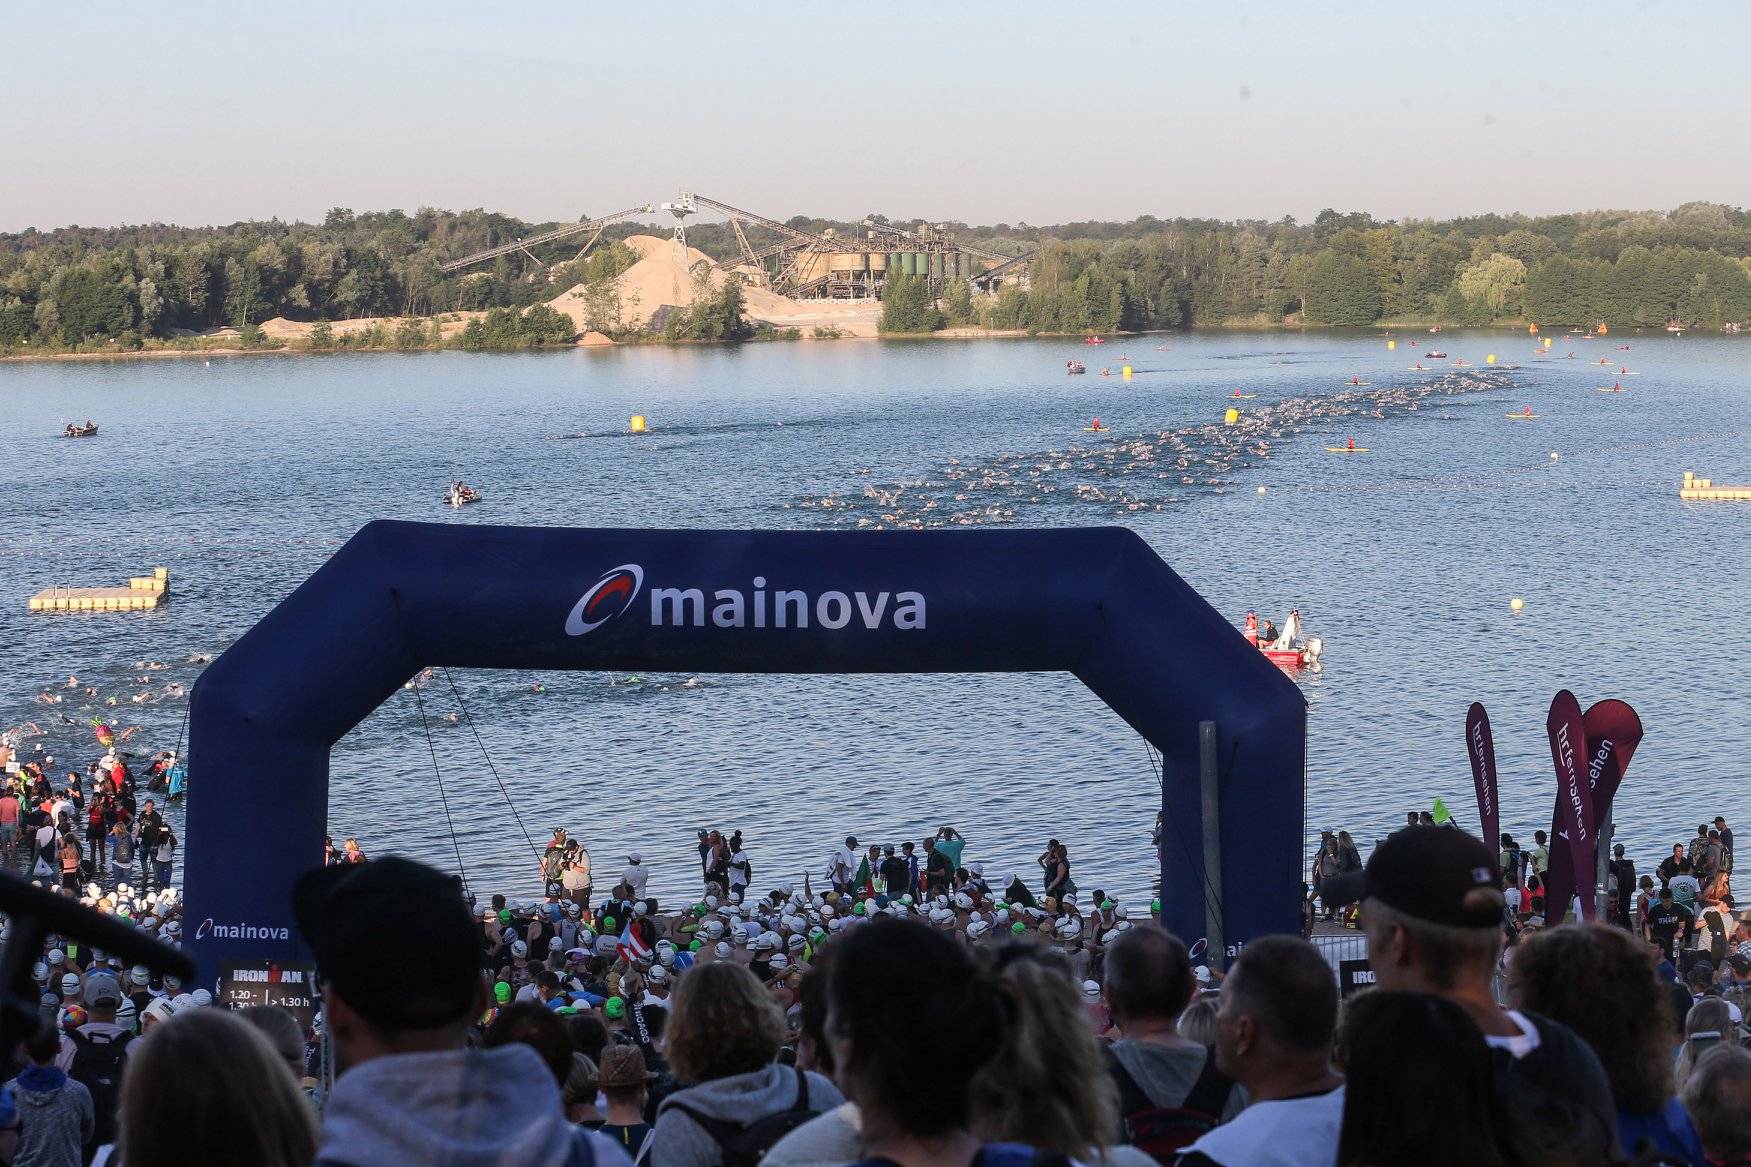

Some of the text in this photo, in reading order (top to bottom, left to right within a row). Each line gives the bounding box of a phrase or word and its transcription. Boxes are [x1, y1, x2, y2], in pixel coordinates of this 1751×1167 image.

[650, 576, 927, 630] mainova
[213, 922, 289, 940] mainova
[233, 966, 302, 983] IRONMAN
[229, 990, 251, 999] 1.20
[281, 997, 302, 1007] 1.30
